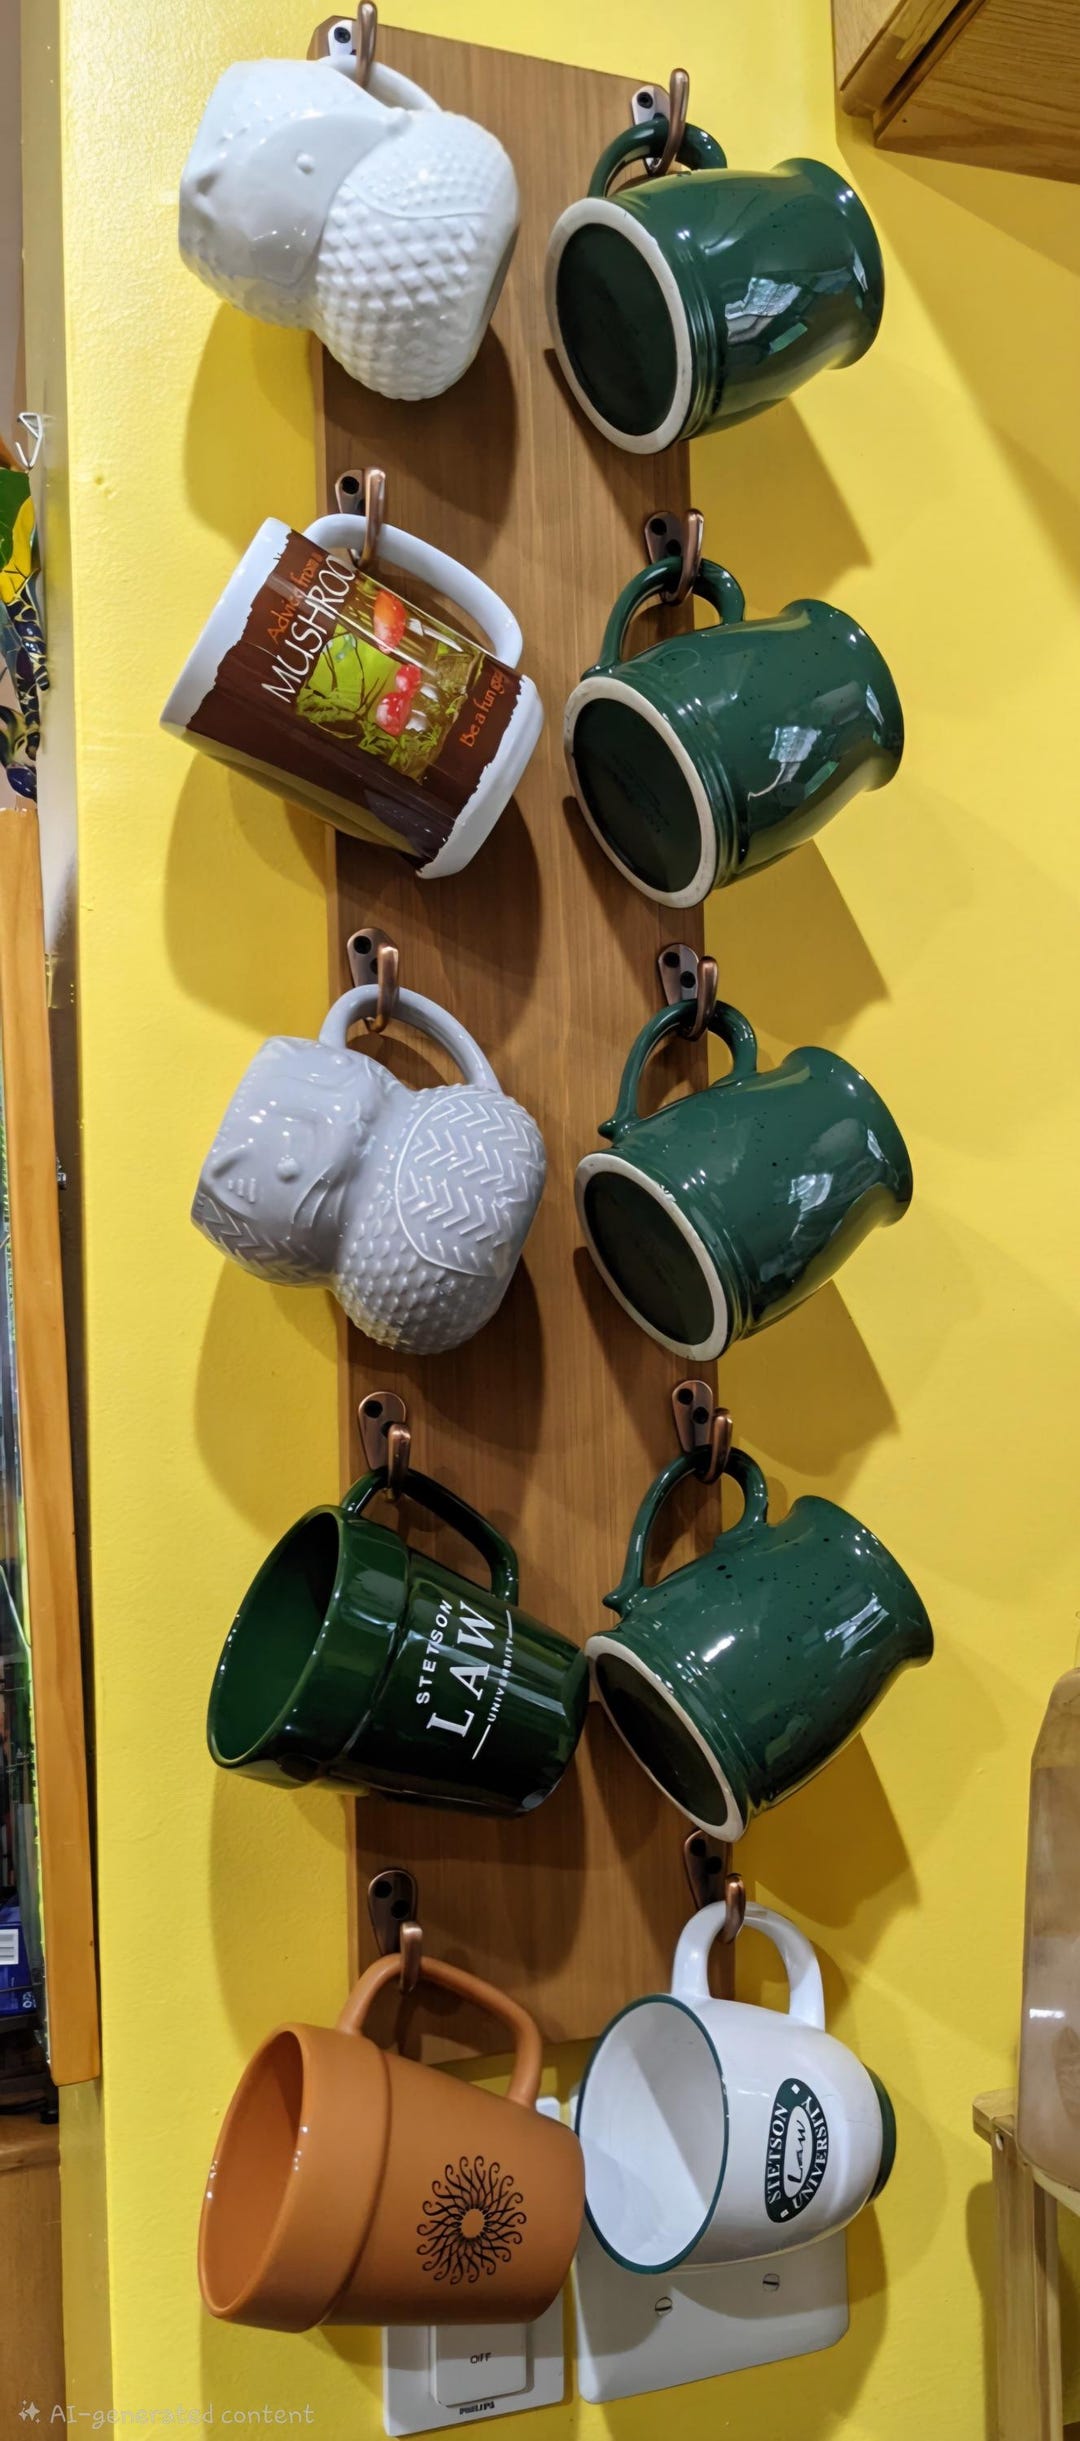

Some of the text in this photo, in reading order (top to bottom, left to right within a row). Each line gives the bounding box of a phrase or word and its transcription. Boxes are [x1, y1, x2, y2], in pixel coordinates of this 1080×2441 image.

[261, 554, 356, 704] MUSHROO
[460, 723, 480, 747] Be
[473, 689, 497, 713] fun
[475, 713, 486, 725] a
[416, 1600, 453, 1704] STETSON
[426, 1601, 496, 1737] LAW
[487, 1638, 514, 1723] UNIVERSITY
[768, 2103, 789, 2204] STETSON
[787, 2119, 806, 2183] Law
[792, 2096, 828, 2209] UNIVERSITY
[470, 2352, 492, 2364] OFF
